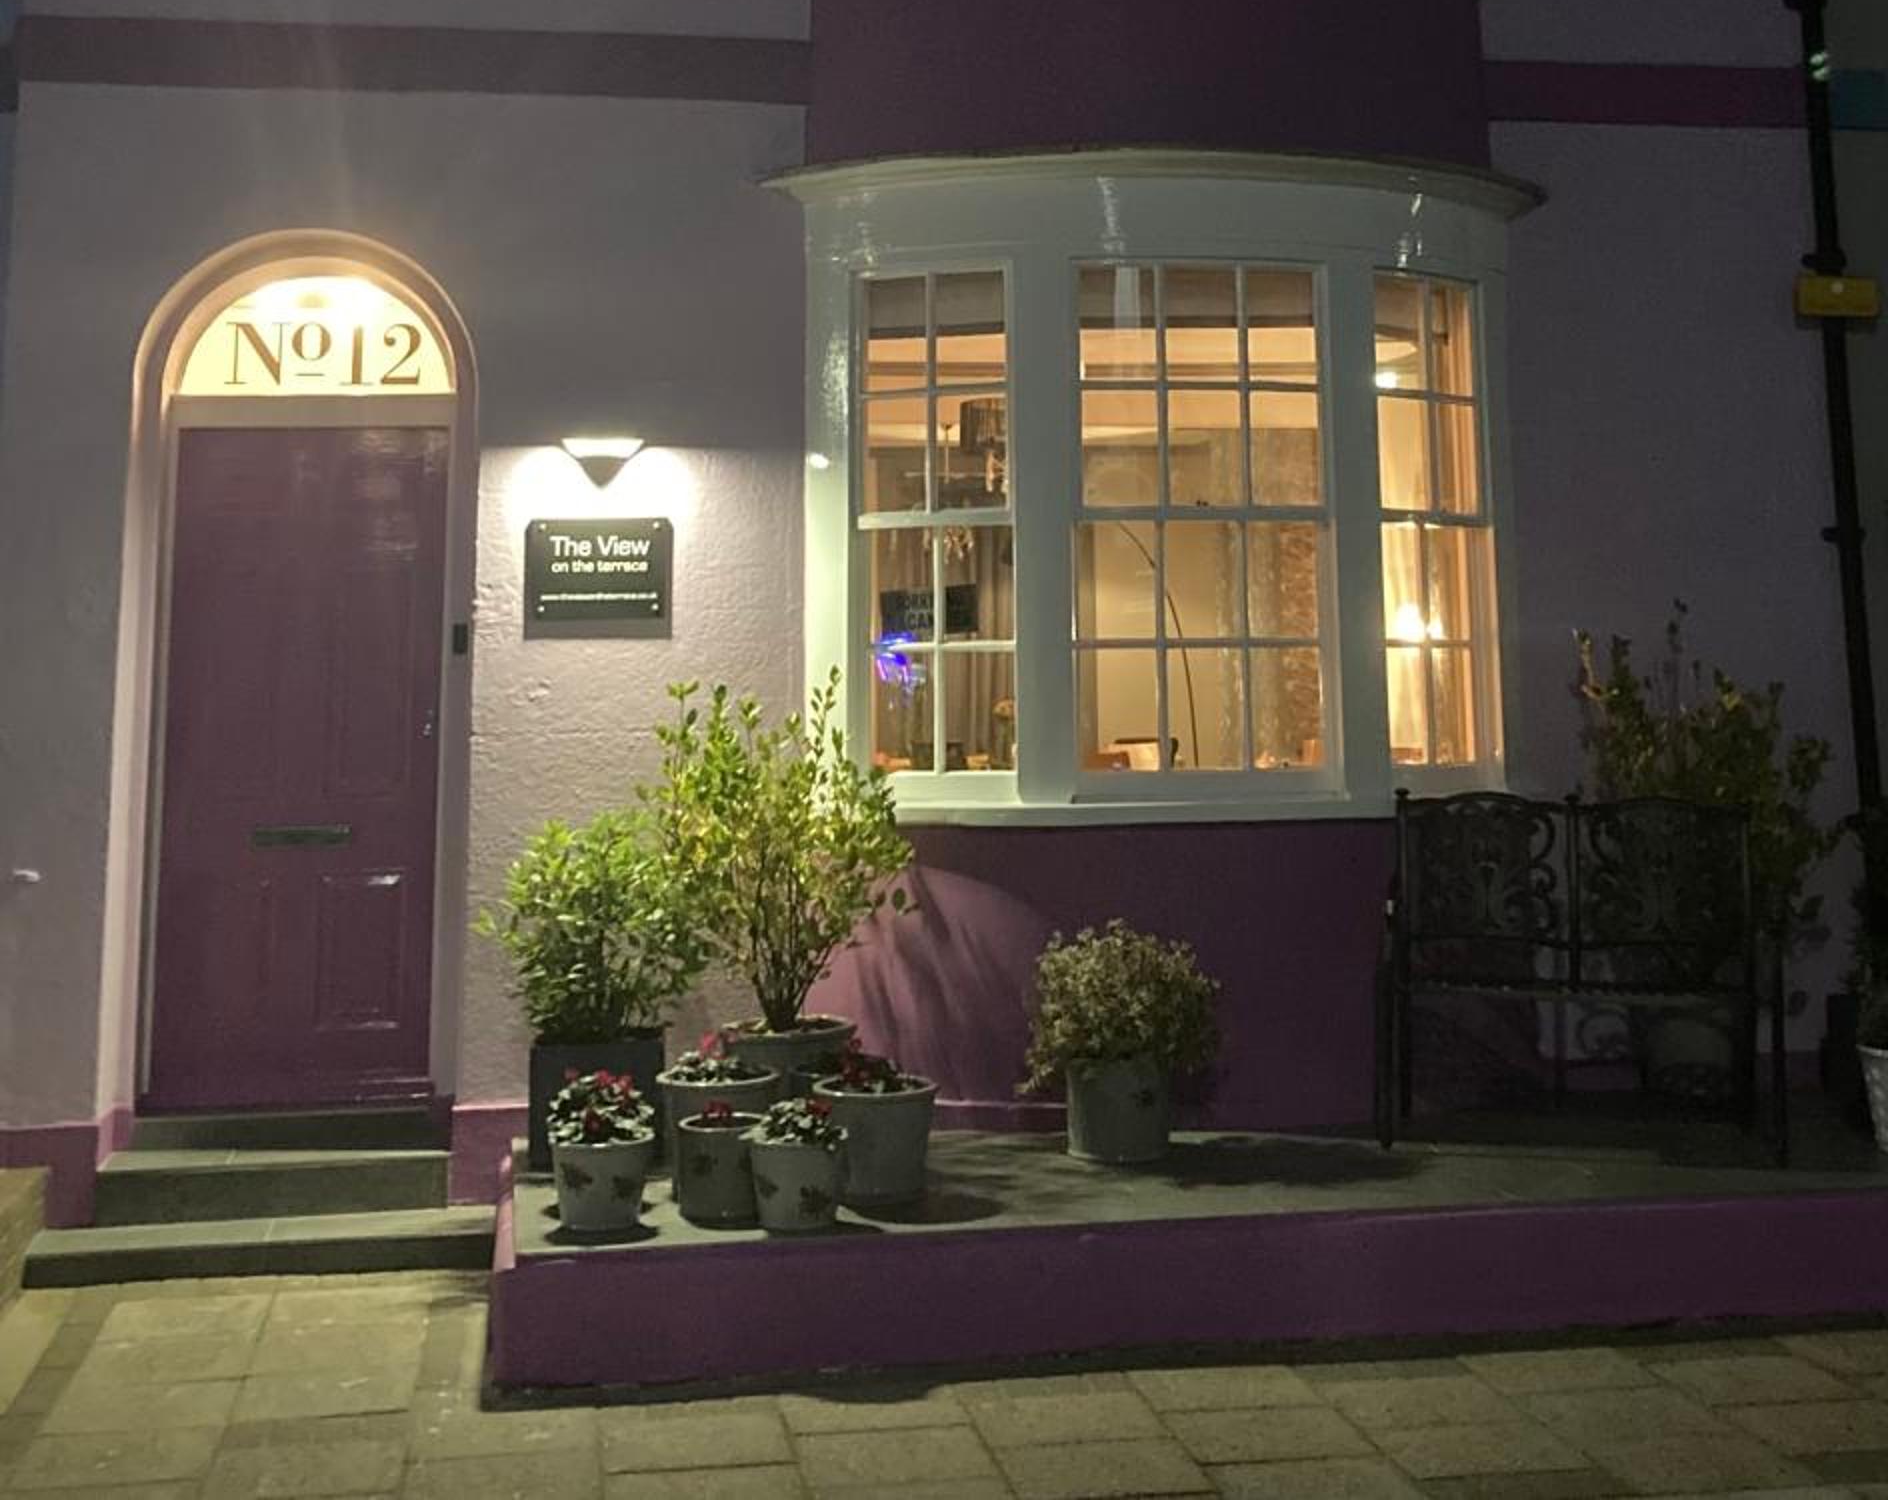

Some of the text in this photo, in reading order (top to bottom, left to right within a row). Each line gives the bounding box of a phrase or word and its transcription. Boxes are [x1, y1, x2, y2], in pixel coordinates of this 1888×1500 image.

[549, 534, 651, 557] The View
[551, 559, 649, 573] on the terrace
